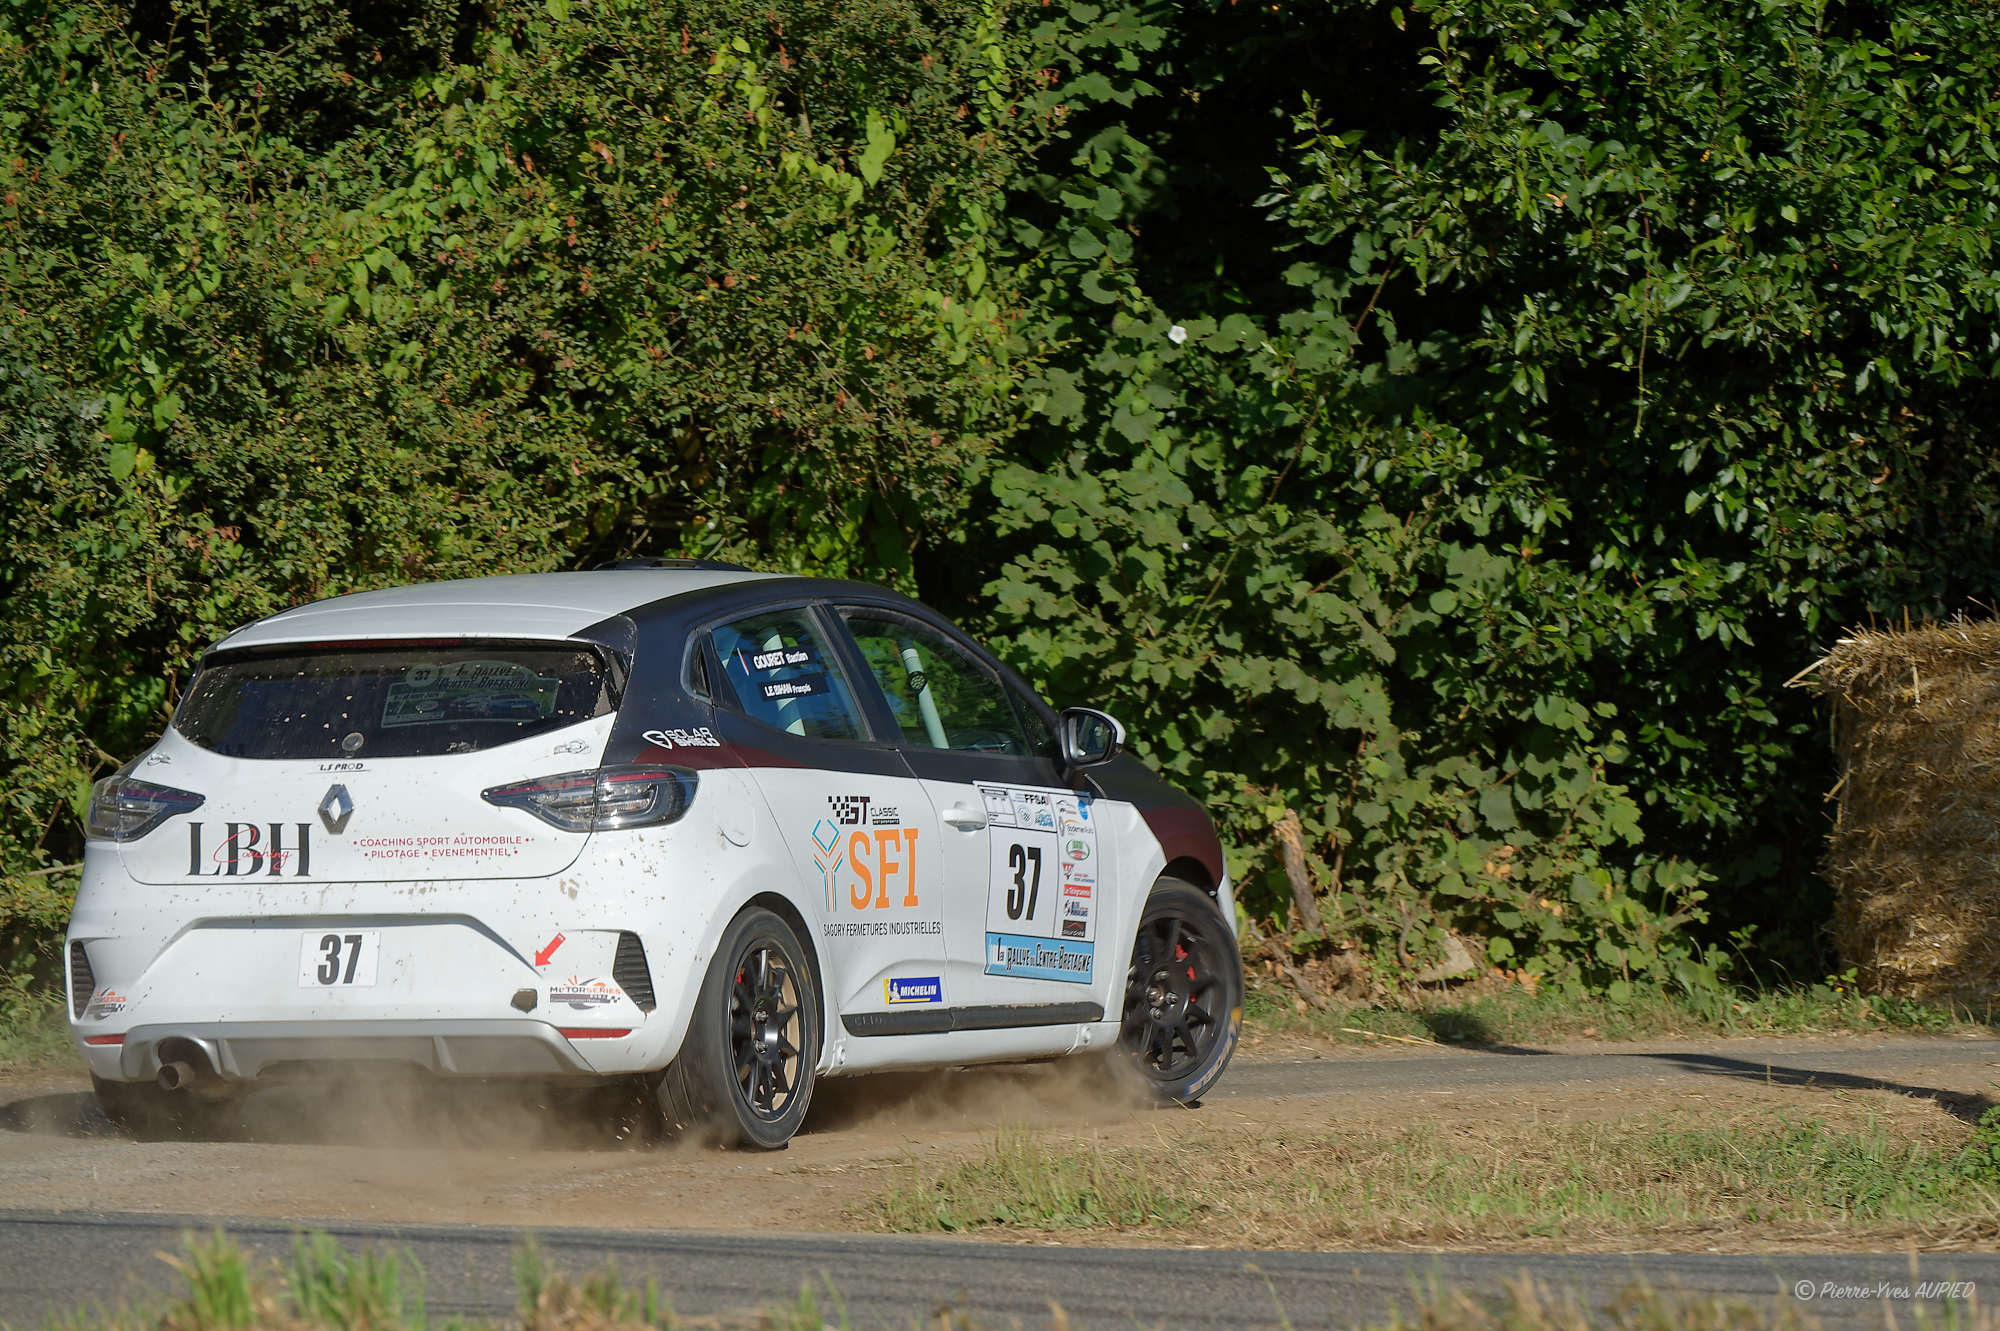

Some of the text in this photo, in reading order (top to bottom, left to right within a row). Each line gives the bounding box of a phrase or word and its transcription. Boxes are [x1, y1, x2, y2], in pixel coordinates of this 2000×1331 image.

[753, 651, 785, 669] GOURET
[665, 727, 713, 739] SOLAR
[870, 807, 898, 817] CLASSIC
[187, 822, 312, 876] LBH
[214, 827, 292, 870] Coaching
[360, 836, 522, 847] COACHING SPORT AUTOMOBILE
[371, 848, 510, 858] PILOTAGE EVENEMENTIEL
[848, 828, 919, 910] SFI
[1006, 843, 1042, 920] 37
[823, 921, 941, 936] SAGORY FERMETURES INDUSTRIELLES
[318, 934, 362, 985] 37
[900, 985, 937, 997] MICHELIN
